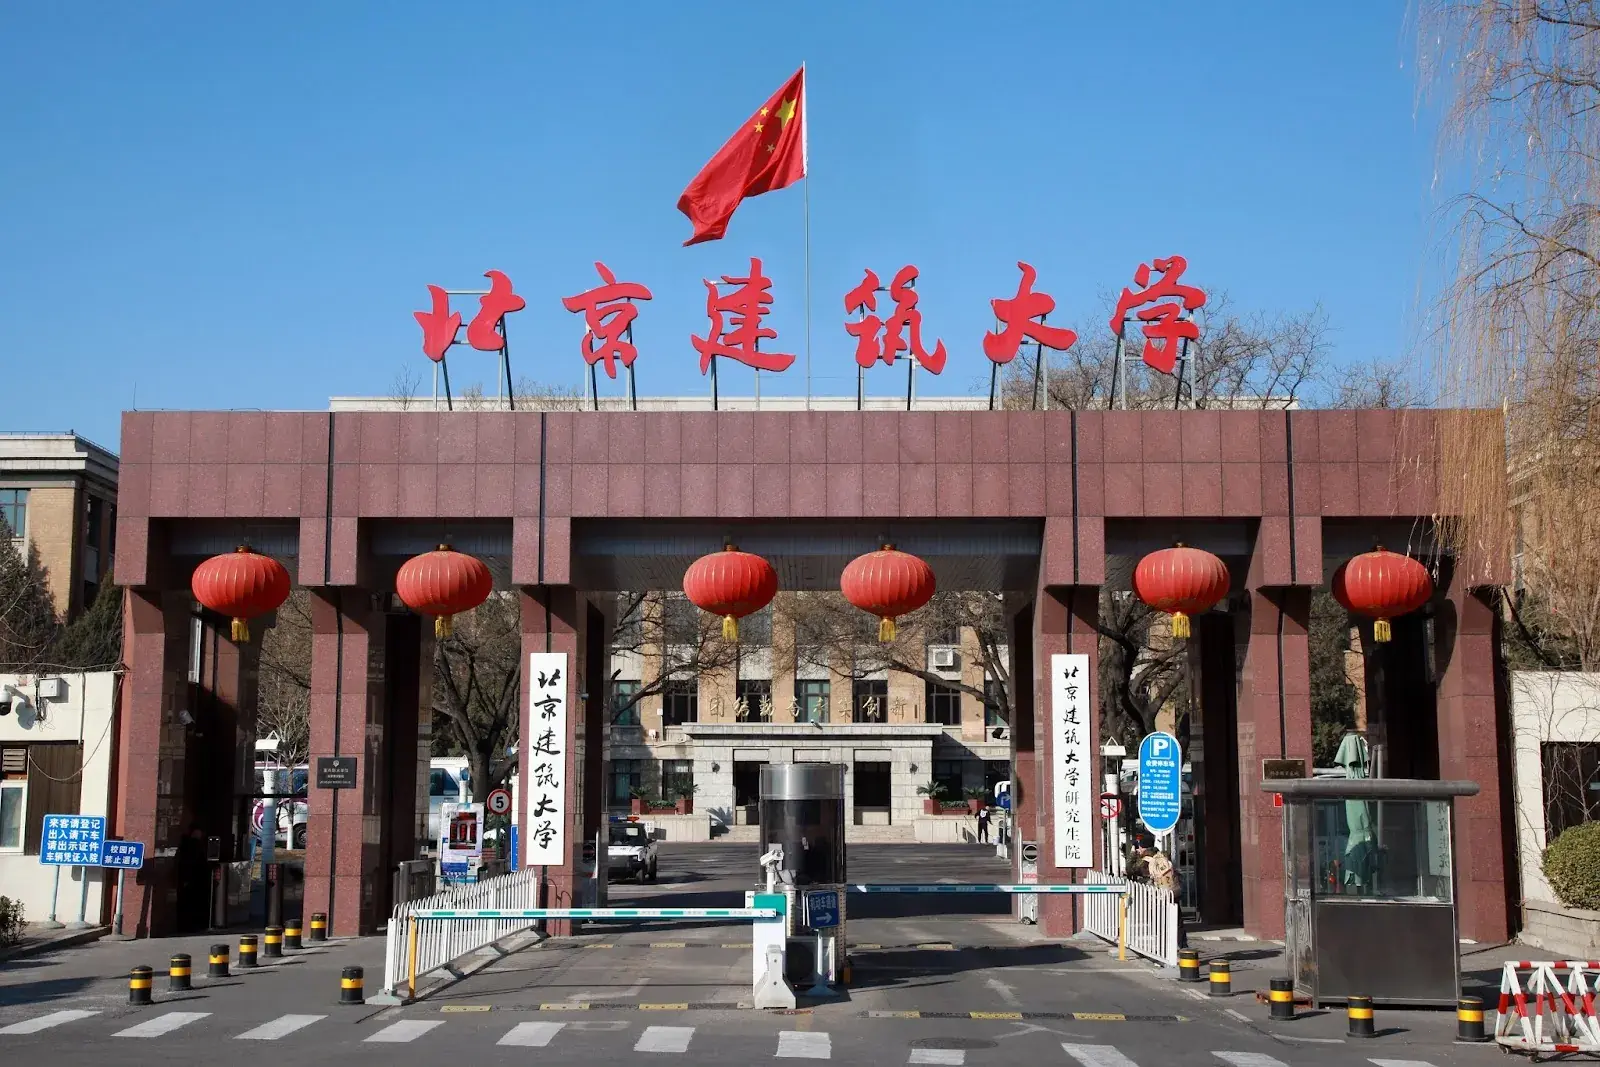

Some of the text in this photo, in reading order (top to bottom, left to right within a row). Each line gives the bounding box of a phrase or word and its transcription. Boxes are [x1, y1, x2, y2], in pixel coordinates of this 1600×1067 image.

[413, 255, 1207, 378] 北京建筑大学
[1153, 739, 1169, 756] P
[532, 669, 562, 849] 北京建筑大学
[1063, 666, 1081, 860] 北京建筑大学研究生院
[496, 796, 504, 809] 5
[49, 818, 101, 829] 来客请登记
[48, 830, 100, 840] 出入请下车
[47, 841, 99, 851] 请出示证件
[110, 845, 136, 854] 校园内
[46, 852, 99, 863] 车辆凭证入院
[104, 855, 140, 866] 禁止遛狗
